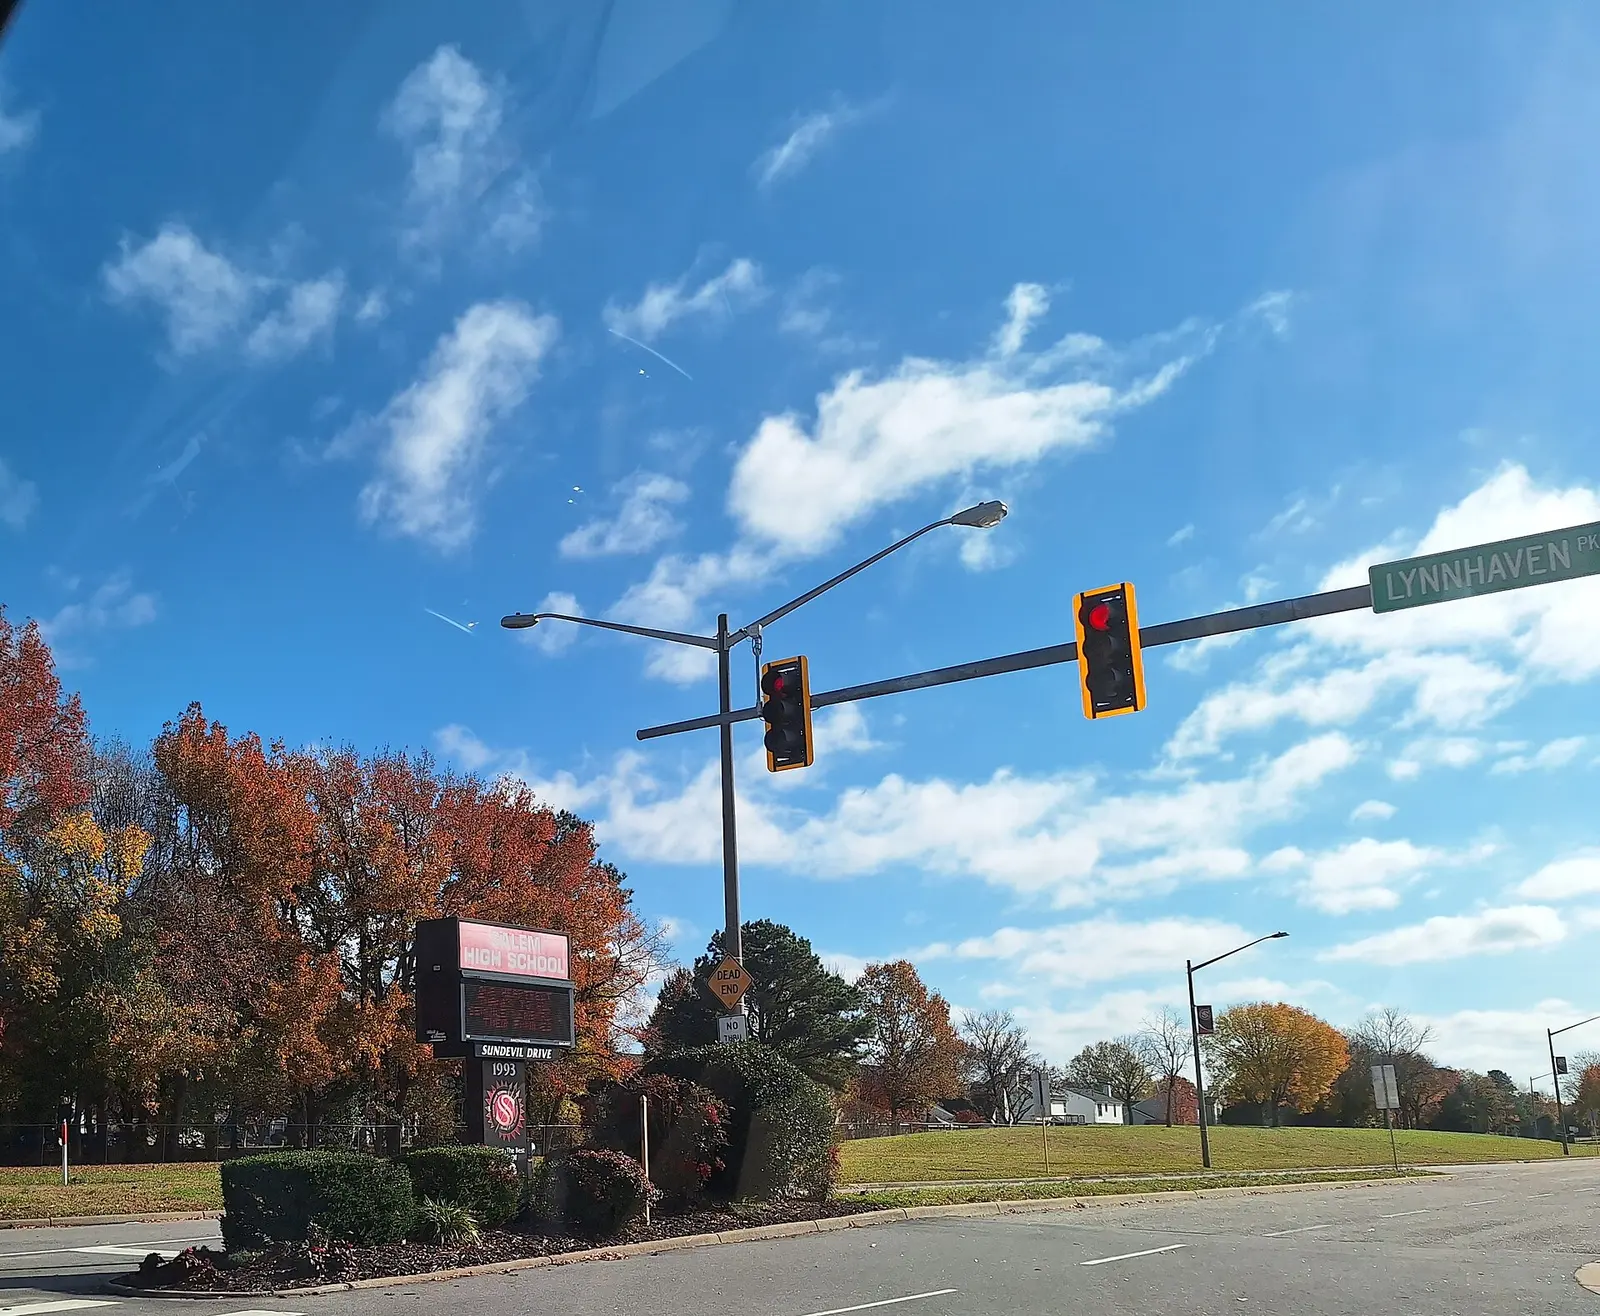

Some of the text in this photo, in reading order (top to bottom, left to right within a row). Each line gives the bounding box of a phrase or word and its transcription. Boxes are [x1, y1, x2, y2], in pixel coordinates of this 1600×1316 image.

[1386, 539, 1571, 601] LYNNHAVEN
[490, 930, 541, 953] SALEM
[464, 947, 565, 974] HIGH SCHOOL
[717, 970, 740, 980] DEAD
[721, 984, 738, 994] END
[726, 1022, 738, 1031] NO
[482, 1045, 552, 1059] SUNDEVIL DRIVE
[492, 1062, 516, 1076] 1993
